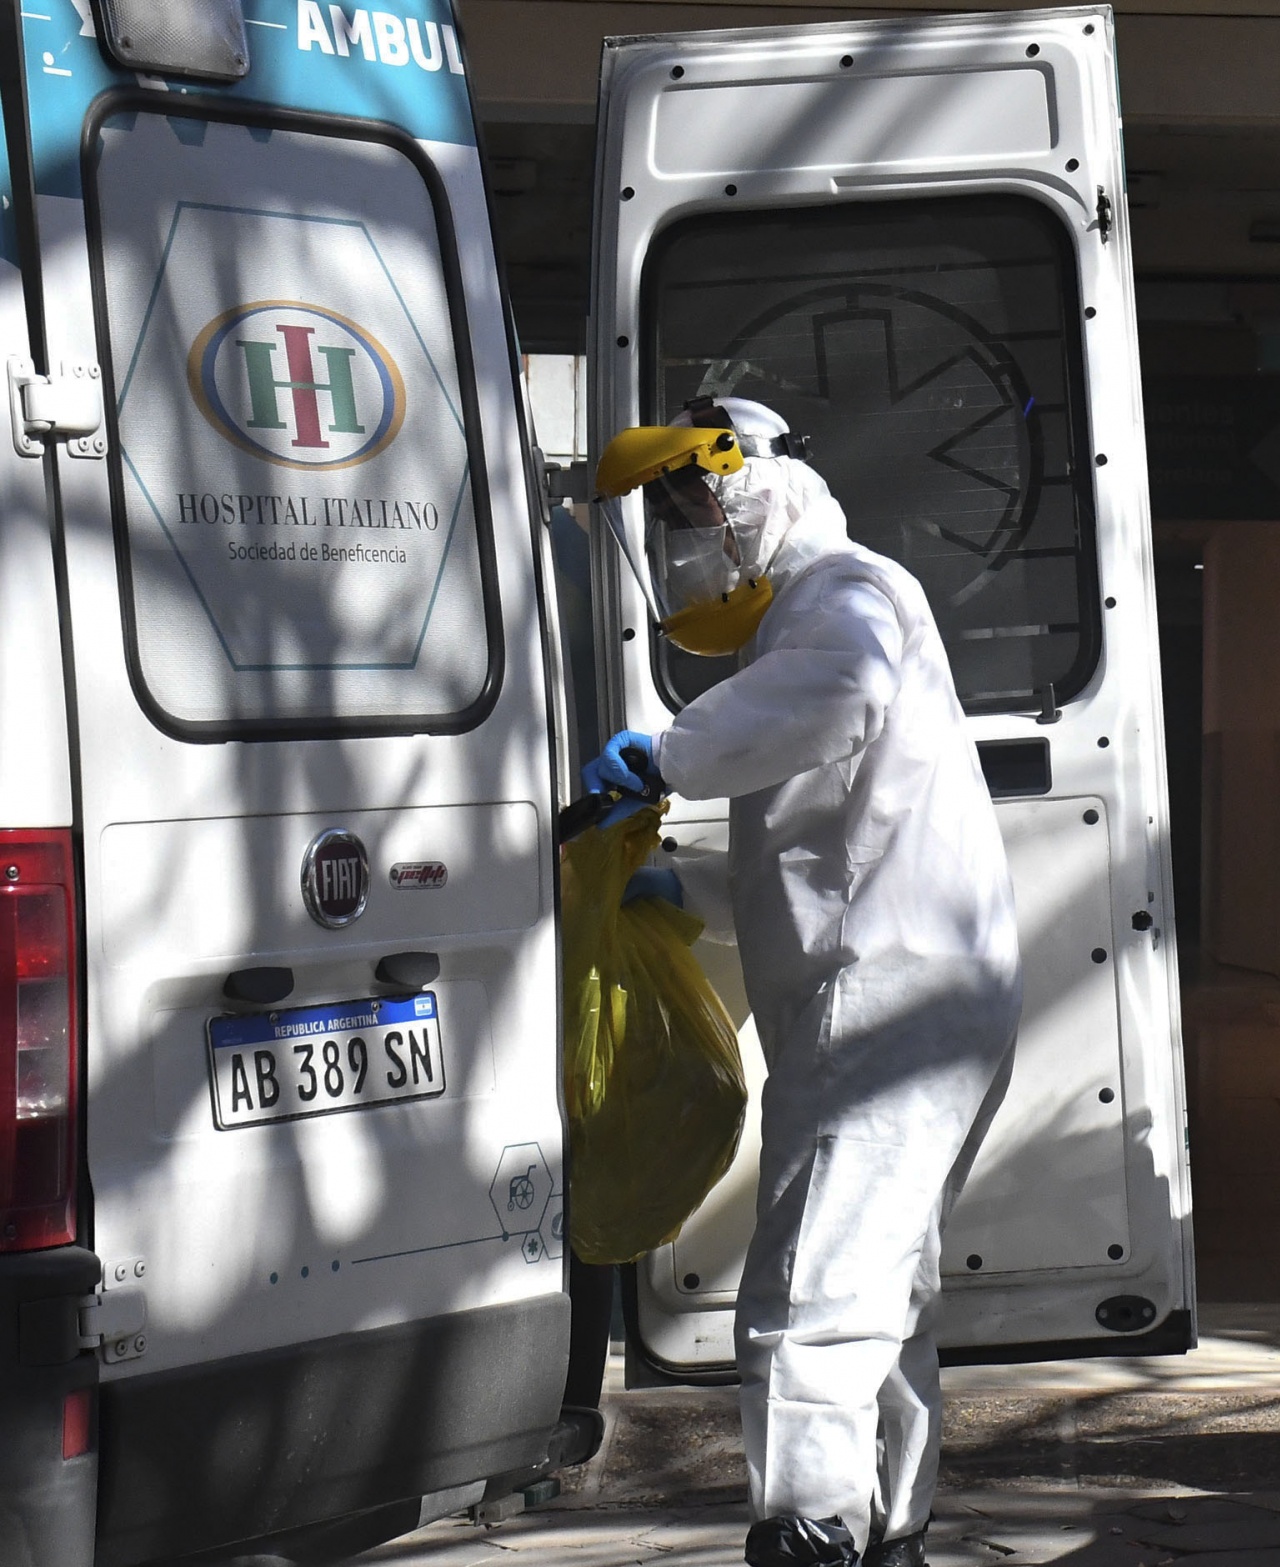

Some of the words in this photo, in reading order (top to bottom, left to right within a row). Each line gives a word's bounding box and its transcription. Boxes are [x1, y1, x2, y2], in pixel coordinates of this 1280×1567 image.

[298, 0, 465, 75] AMBUL
[176, 493, 316, 526] HOSPITAL
[322, 497, 439, 531] ITALIANO
[228, 541, 296, 561] Sociedad
[300, 543, 318, 561] de
[322, 543, 407, 563] Beneficencia
[321, 857, 358, 901] FIAT
[274, 1020, 326, 1038] REPUBLICA
[327, 1013, 379, 1031] ARGENTINA
[231, 1050, 280, 1112] AB
[293, 1036, 369, 1102] 389
[384, 1028, 433, 1089] SN
